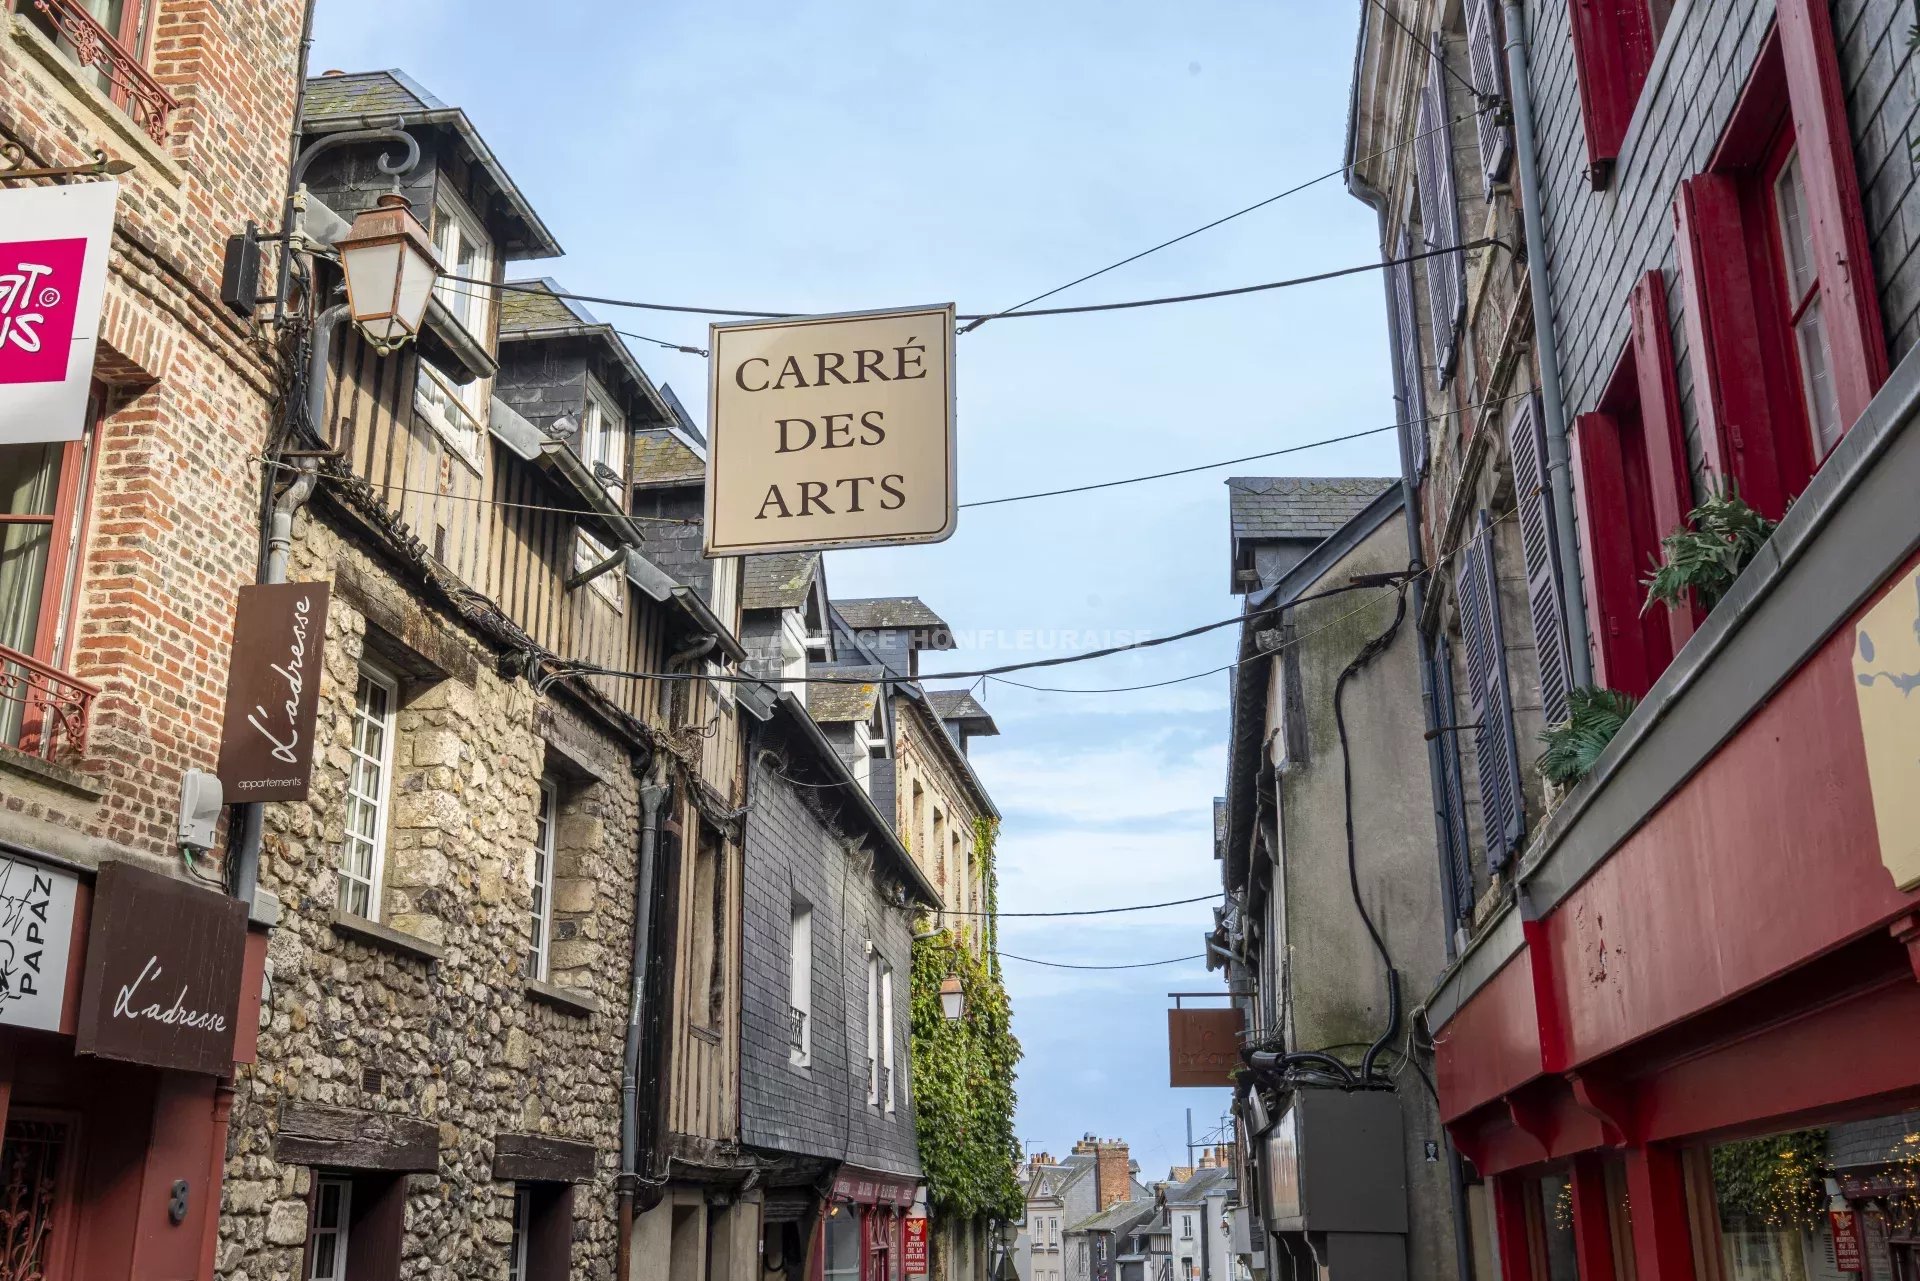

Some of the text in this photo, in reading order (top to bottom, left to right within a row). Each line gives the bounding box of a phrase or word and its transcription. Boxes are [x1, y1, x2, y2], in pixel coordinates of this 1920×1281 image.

[735, 336, 927, 392] CARRÉ
[775, 410, 886, 454] DES
[754, 474, 906, 519] ARTS
[247, 596, 311, 763] L'adresse
[238, 777, 302, 790] appartements
[19, 874, 53, 995] PAPAZ
[113, 955, 227, 1032] L'adresse
[168, 1179, 189, 1226] 8
